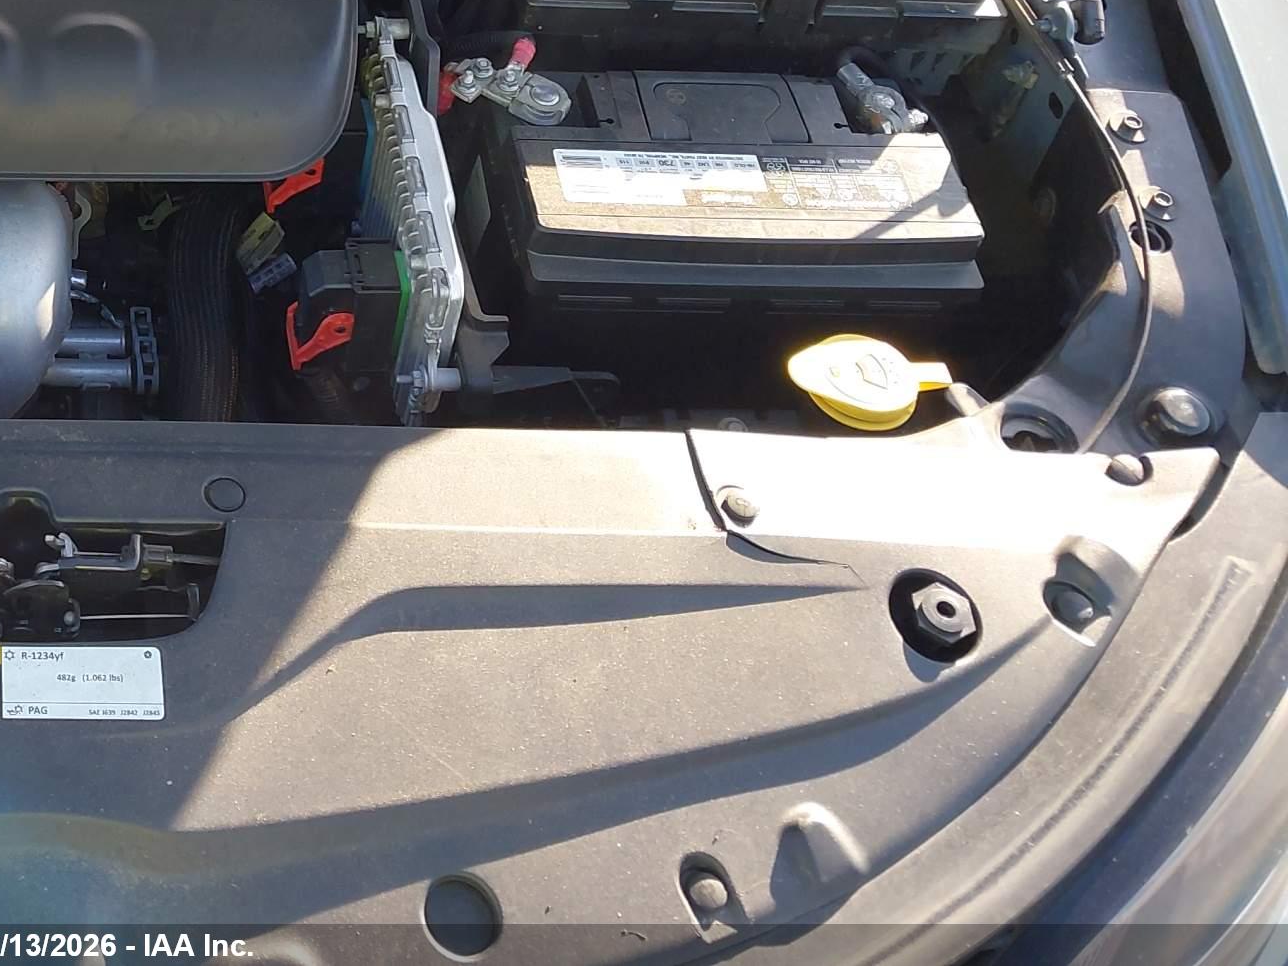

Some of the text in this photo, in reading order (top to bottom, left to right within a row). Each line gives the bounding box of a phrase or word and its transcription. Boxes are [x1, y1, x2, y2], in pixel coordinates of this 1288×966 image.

[21, 651, 65, 662] R-1234yf
[56, 673, 124, 683] 482g (1.062 lbs)
[28, 706, 48, 715] PAG
